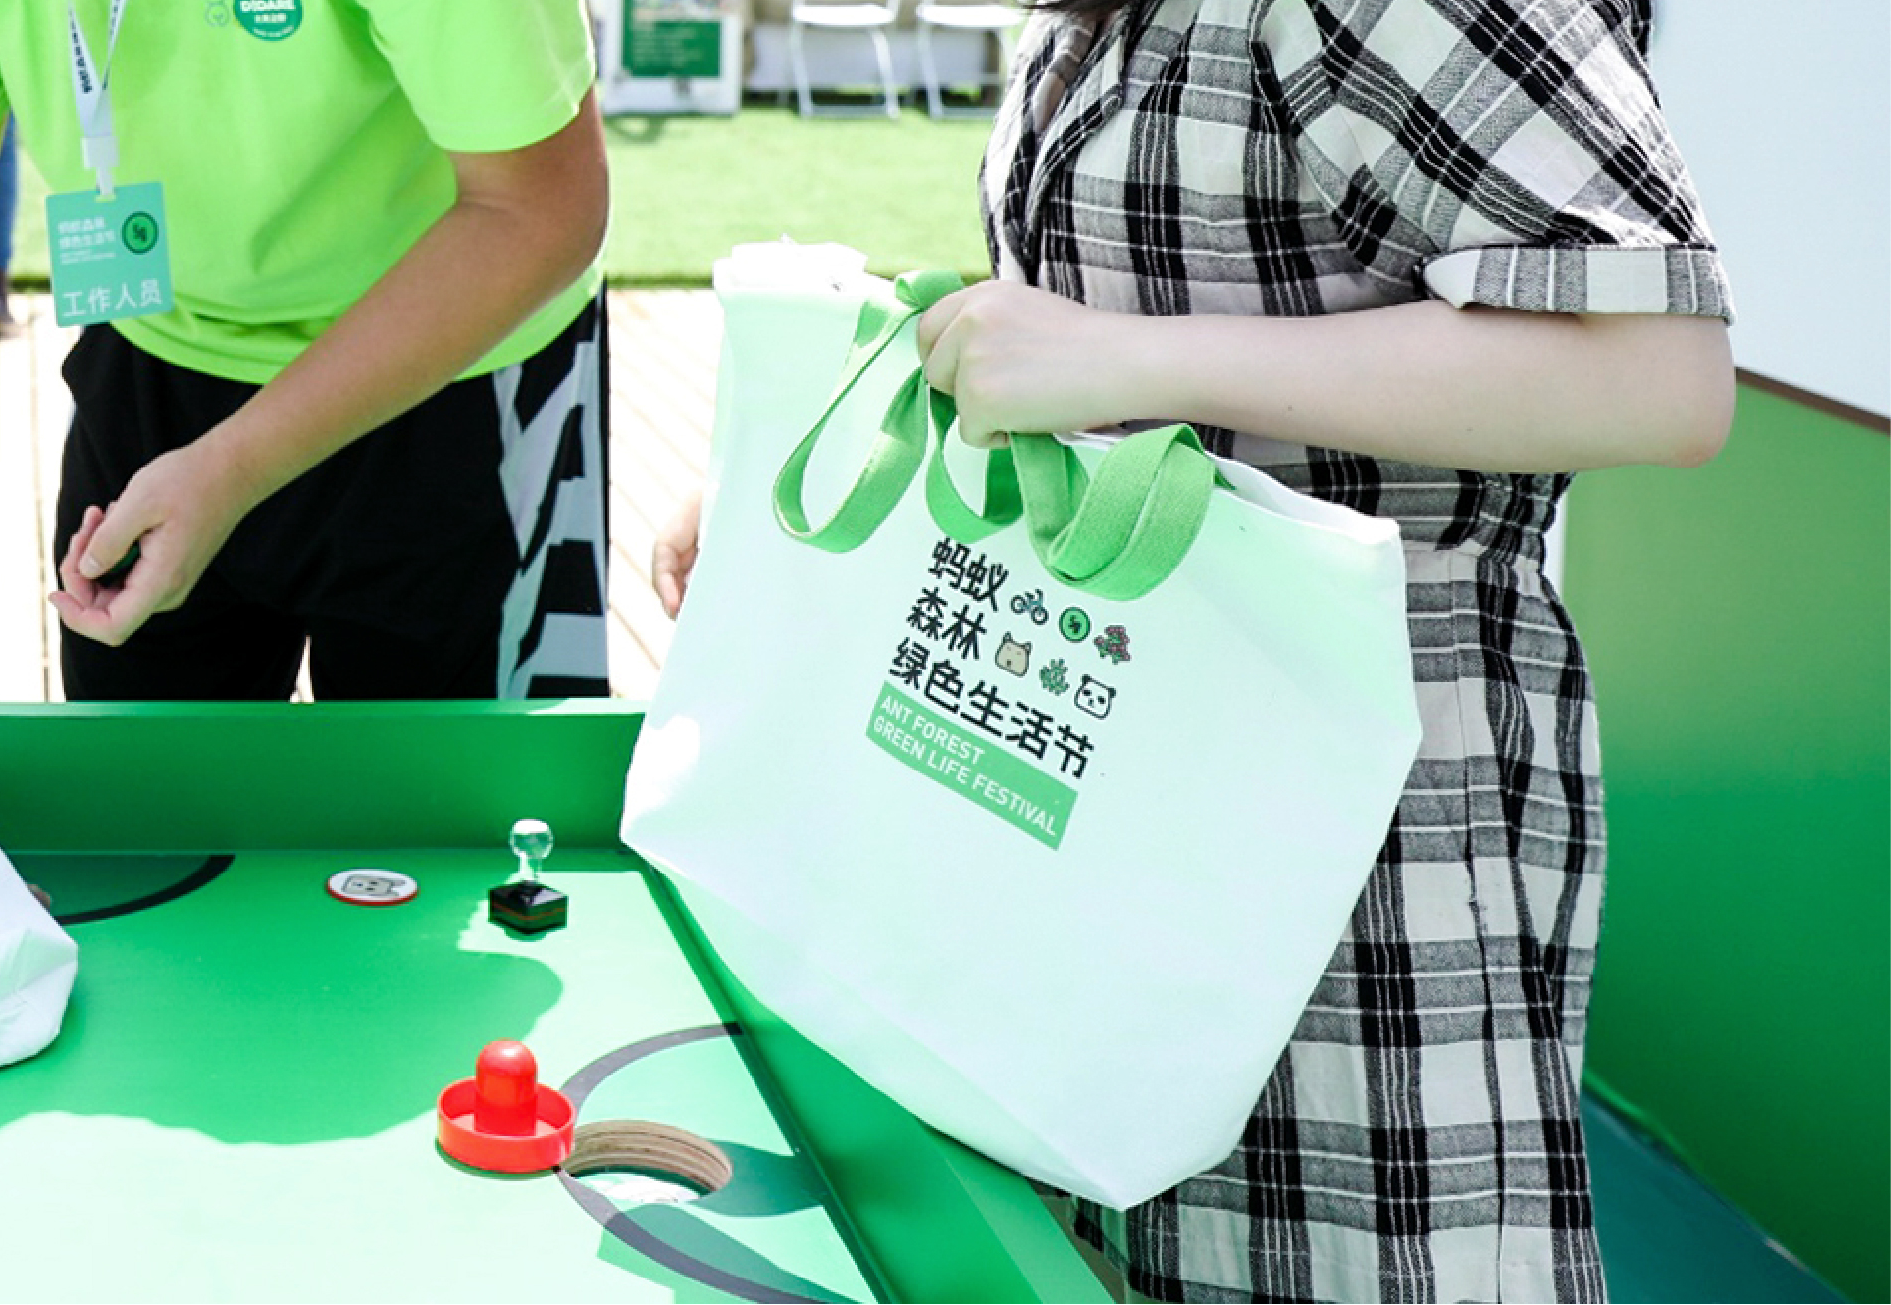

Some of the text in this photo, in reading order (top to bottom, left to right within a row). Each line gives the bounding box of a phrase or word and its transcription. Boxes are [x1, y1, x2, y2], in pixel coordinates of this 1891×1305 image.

[62, 277, 164, 319] 工作人员
[927, 536, 1010, 613] 蚂蚁
[905, 585, 988, 661] 森林
[879, 694, 986, 766] ANT FOREST
[887, 636, 1095, 780] 绿色生活节
[873, 714, 1058, 838] GREEN LIFE FESTIVAL
